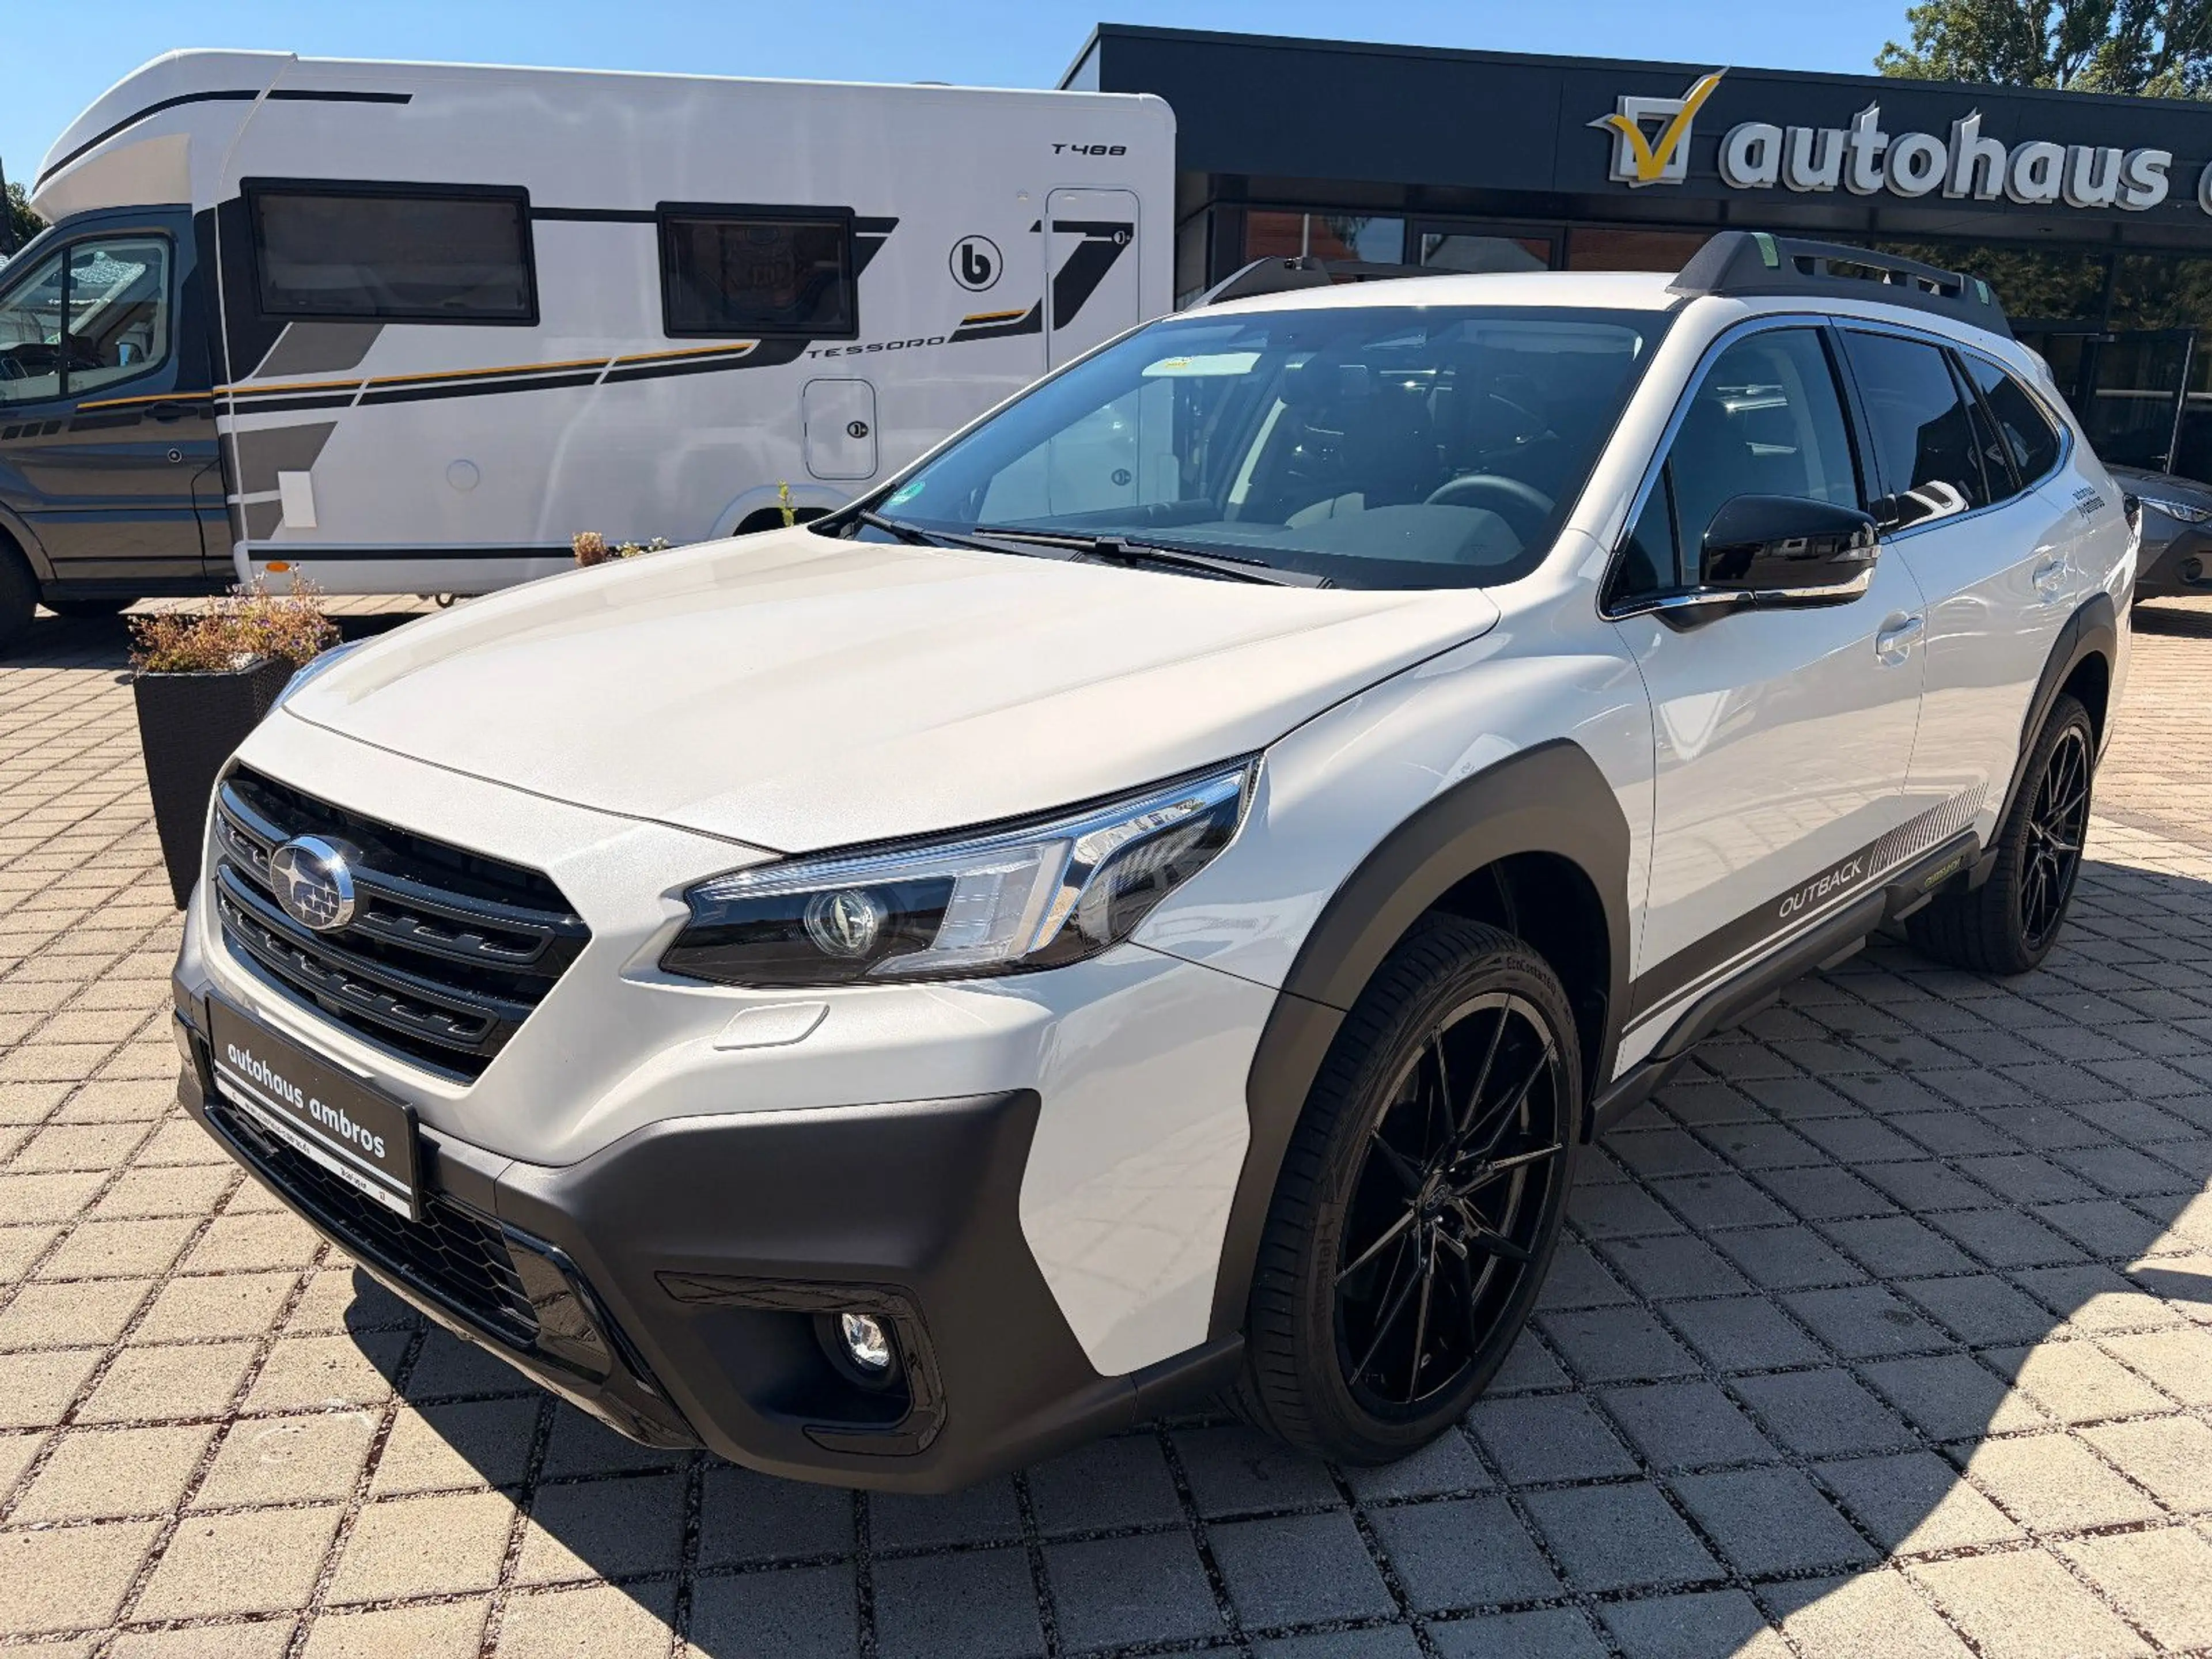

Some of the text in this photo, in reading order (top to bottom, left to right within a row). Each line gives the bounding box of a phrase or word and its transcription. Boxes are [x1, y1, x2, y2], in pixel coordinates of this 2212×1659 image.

[1051, 144, 1127, 156] T 488
[1719, 99, 2172, 211] autohaus
[808, 335, 946, 359] TESSORO
[1779, 856, 1865, 918] OUTBACK
[228, 1043, 304, 1109] autohaus
[309, 1097, 385, 1158] ambros
